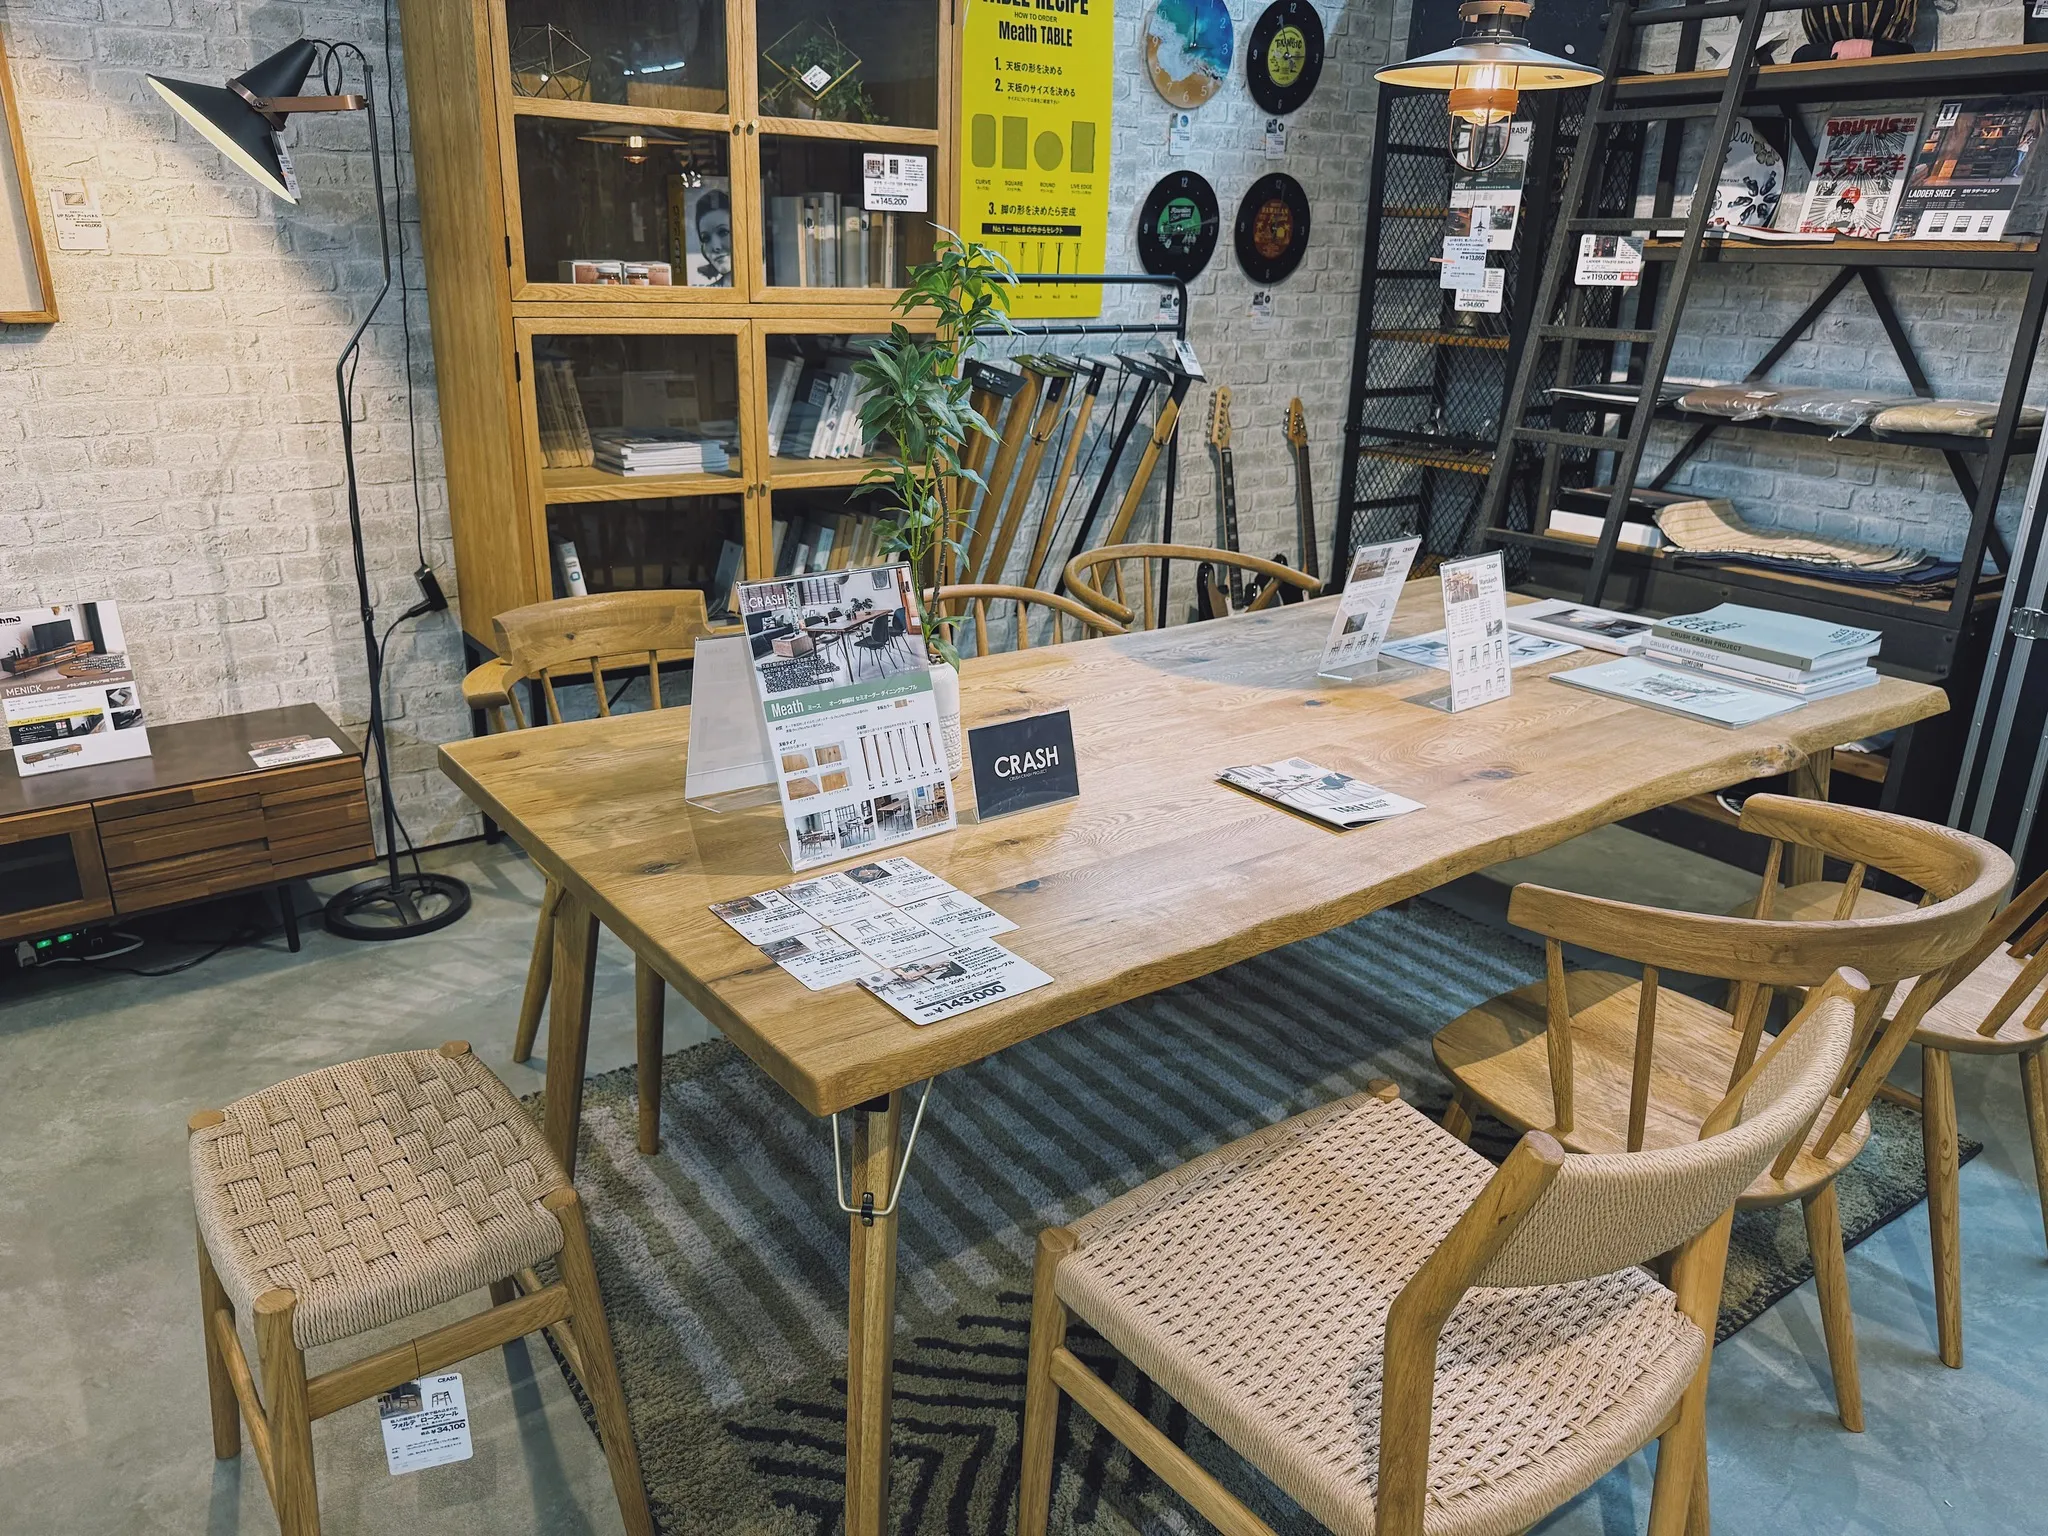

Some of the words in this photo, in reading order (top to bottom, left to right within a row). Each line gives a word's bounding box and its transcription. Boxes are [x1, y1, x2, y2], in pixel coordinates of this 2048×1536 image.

[1014, 11, 1028, 19] HOW
[1038, 14, 1058, 22] ORDER
[1219, 18, 1226, 29] 2
[999, 20, 1037, 43] Meath
[1040, 25, 1073, 47] TABLE
[1152, 36, 1159, 47] 9
[1221, 44, 1229, 55] 3
[994, 57, 1001, 71] 1.
[1006, 61, 1063, 75] 天板の形を決める
[995, 78, 1003, 92] 2.
[1007, 82, 1076, 97] 天板のサイズを決める
[1166, 82, 1173, 94] 7
[1200, 85, 1207, 97] 5
[1182, 91, 1190, 102] 6
[1826, 118, 1901, 136] BRUTUS
[1816, 154, 1907, 179] 大友克洋
[1181, 177, 1188, 188] 12
[1907, 189, 1934, 198] LADDER
[1934, 188, 1957, 198] SHELF
[876, 198, 908, 206] ¥145,200
[988, 202, 996, 215] 3.
[1001, 204, 1076, 217] 脚の形を決めたら完成
[749, 593, 785, 609] CRASH
[1670, 631, 1691, 641] CRUSH
[1691, 636, 1713, 645] CRASH
[1713, 641, 1742, 652] PROJECT
[1649, 640, 1669, 649] CRUSH
[1670, 645, 1691, 654] CRASH
[1691, 649, 1720, 661] PROJECT
[5, 684, 43, 697] MENICK
[771, 699, 805, 718] Meath
[807, 703, 822, 711] ミース
[880, 684, 918, 698] ダイニングテーブル
[994, 745, 1059, 778] CRASH
[948, 946, 972, 957] CRASH
[949, 977, 965, 985] 200
[965, 959, 1015, 980] ダイニングテーブル
[933, 985, 1007, 1014] ¥143,000
[437, 1375, 458, 1383] CRASH
[431, 1423, 466, 1435] ¥34,100
